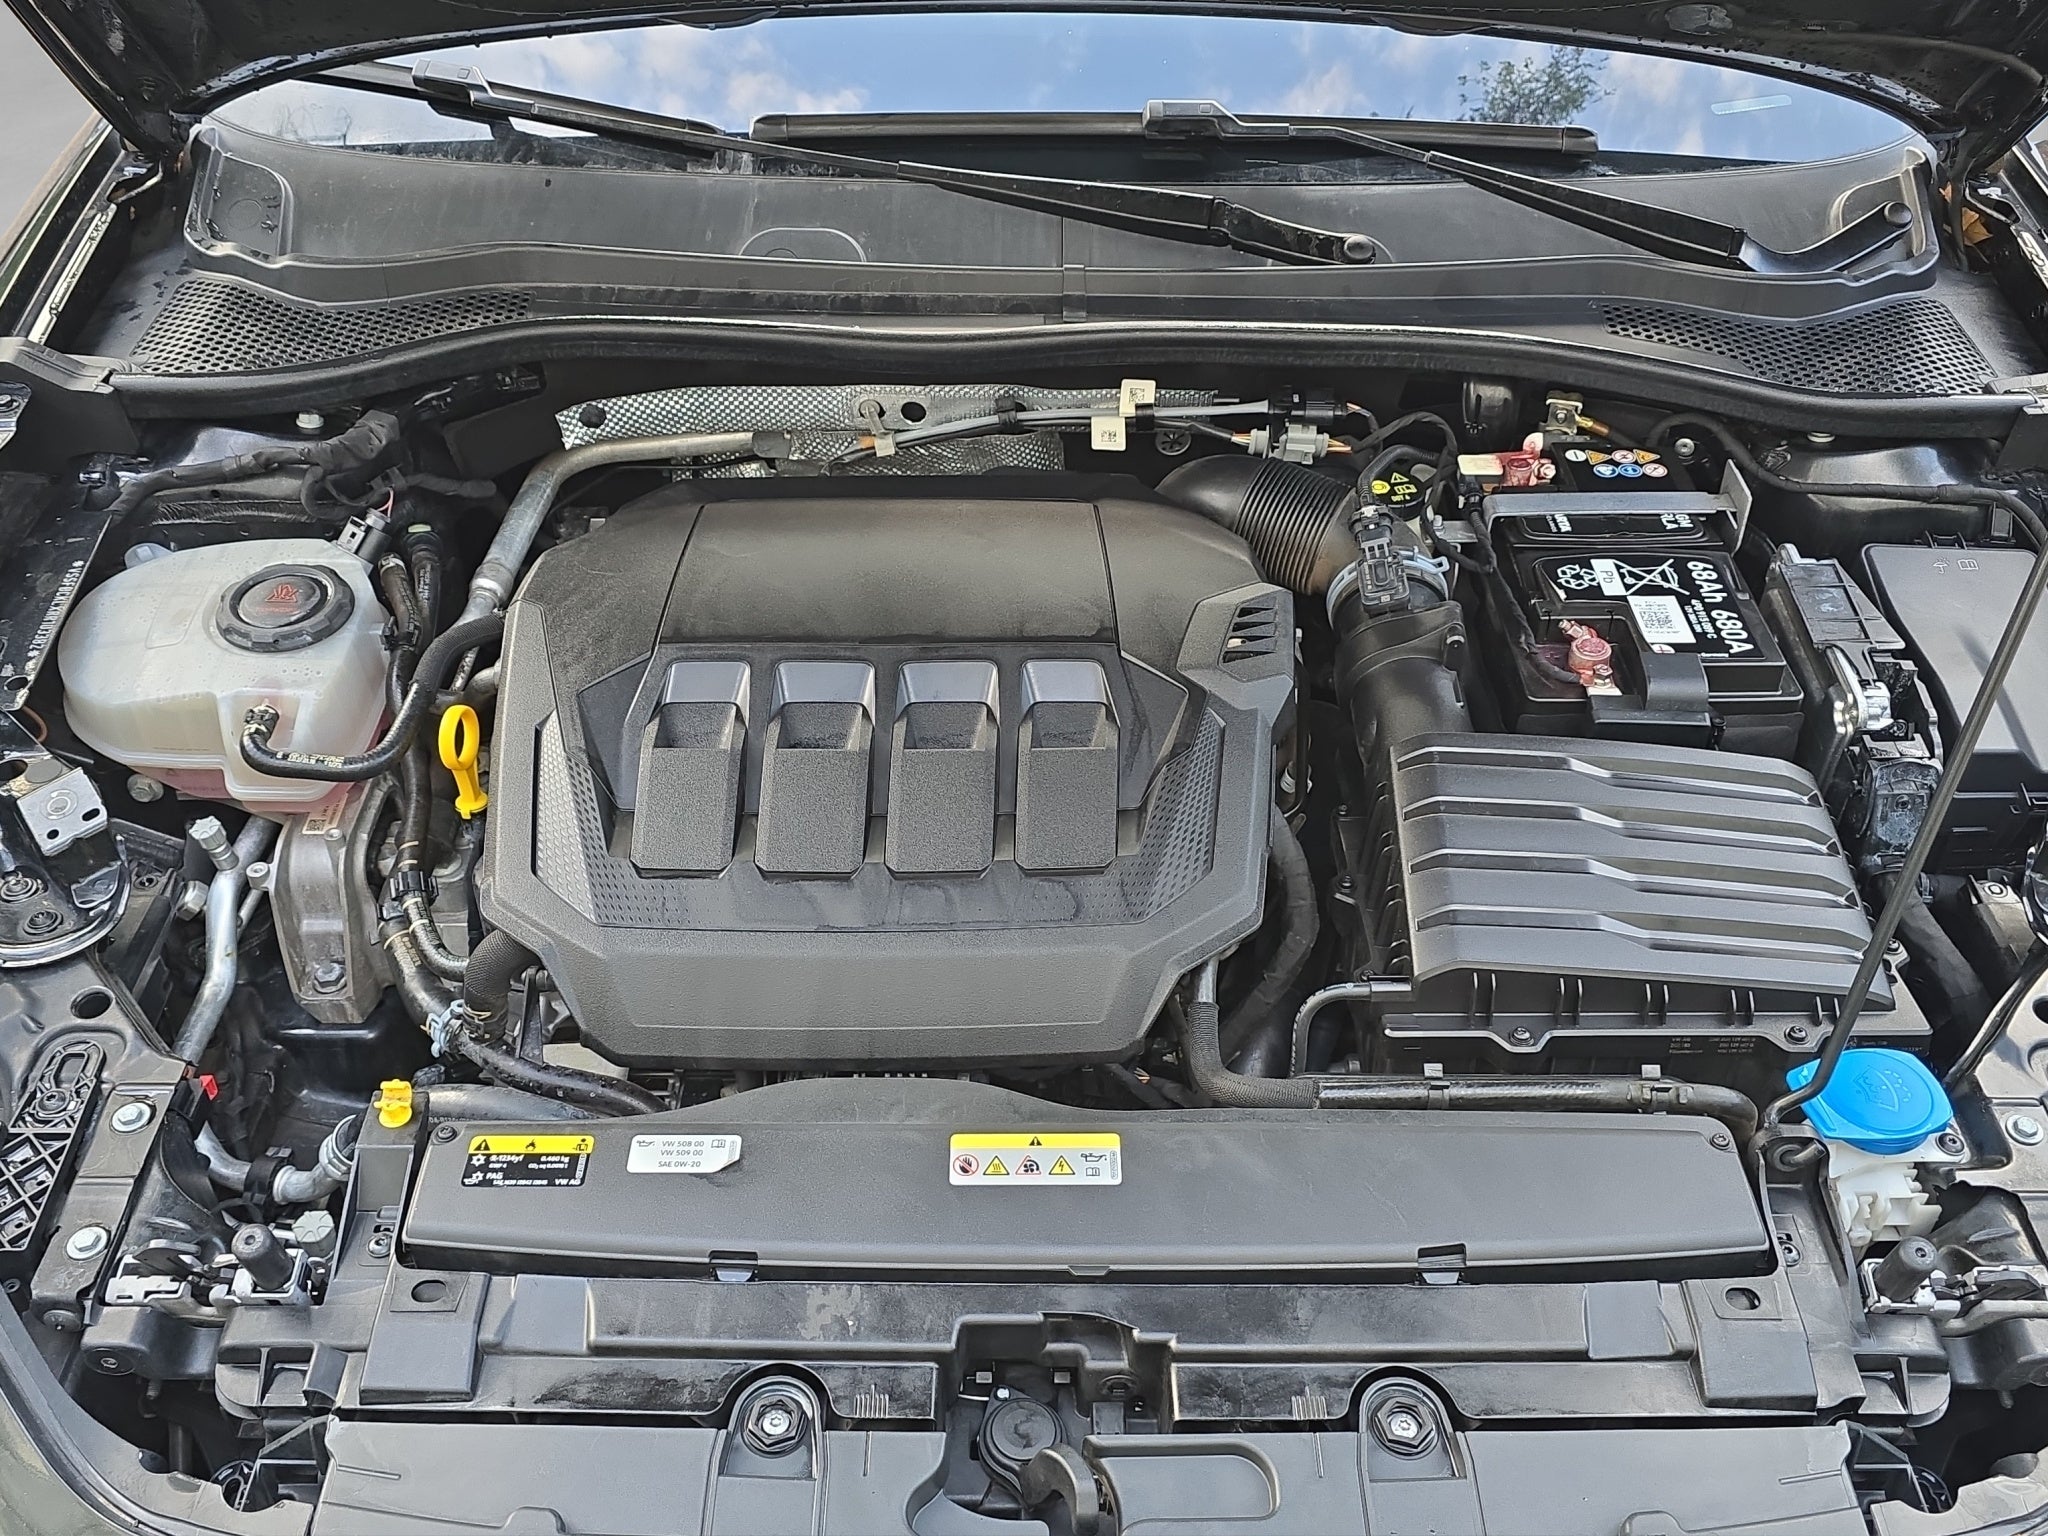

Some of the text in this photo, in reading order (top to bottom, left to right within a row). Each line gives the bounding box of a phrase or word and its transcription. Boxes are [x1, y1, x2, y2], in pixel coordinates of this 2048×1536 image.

[1660, 513, 1679, 530] RLA
[1675, 513, 1694, 528] GM
[1599, 570, 1615, 583] Pb
[1686, 561, 1755, 654] 68Ah 680A
[485, 1171, 504, 1180] PAG
